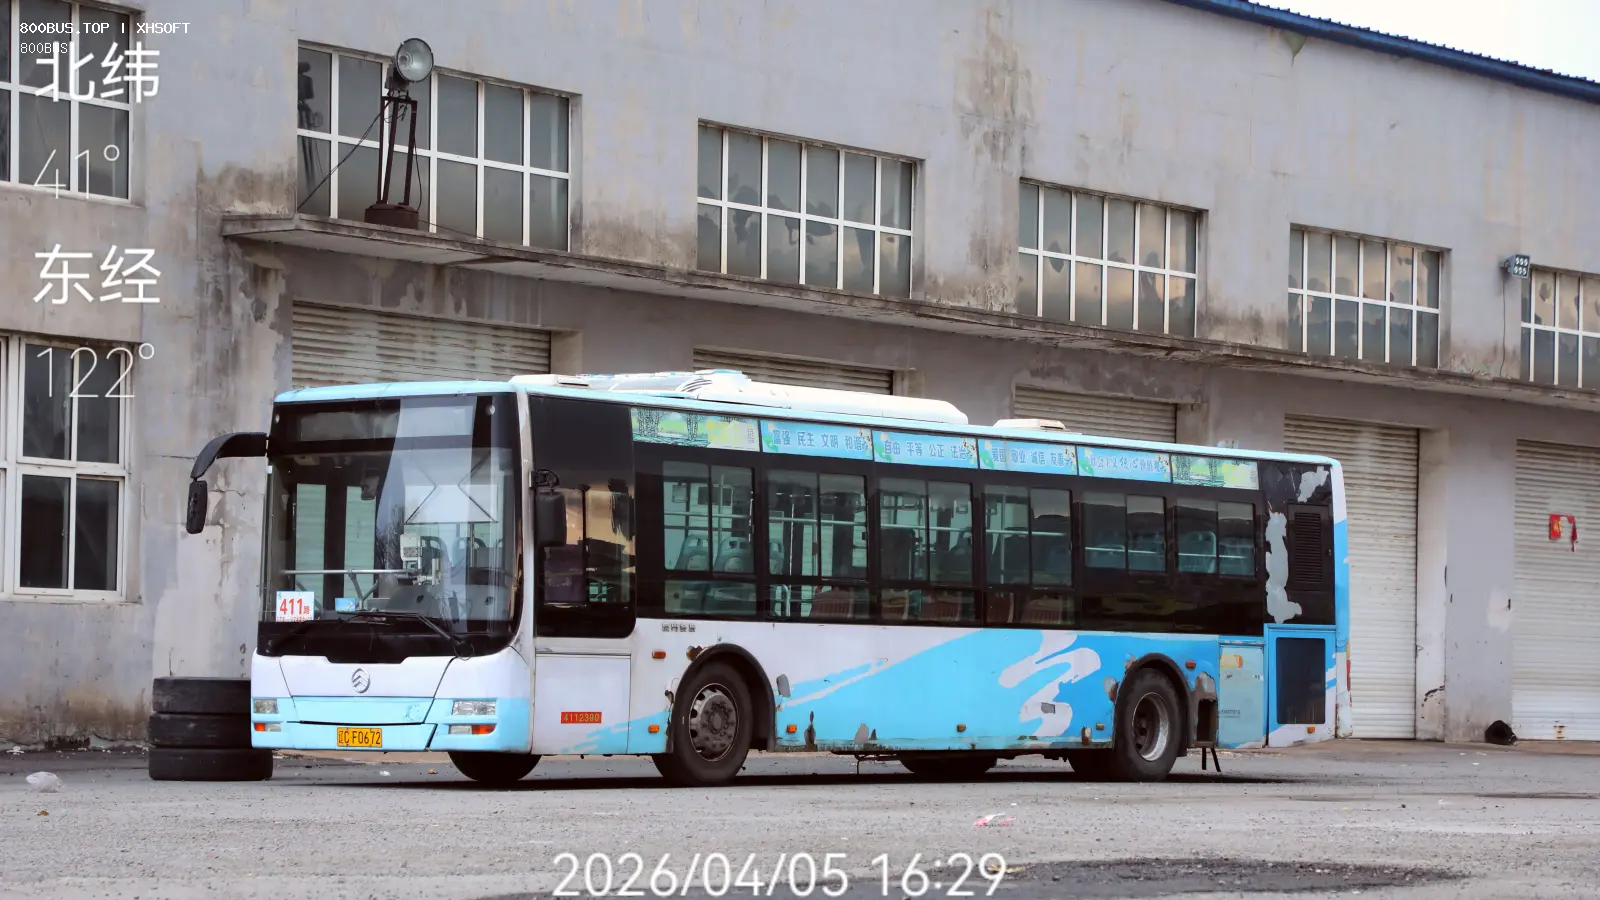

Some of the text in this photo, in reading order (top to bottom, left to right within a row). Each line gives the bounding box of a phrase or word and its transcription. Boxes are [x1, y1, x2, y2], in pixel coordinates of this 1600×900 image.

[797, 431, 815, 447] 民主
[821, 433, 839, 449] 文明
[884, 440, 900, 455] 自由
[907, 441, 922, 457] 平等
[929, 443, 945, 458] 公正
